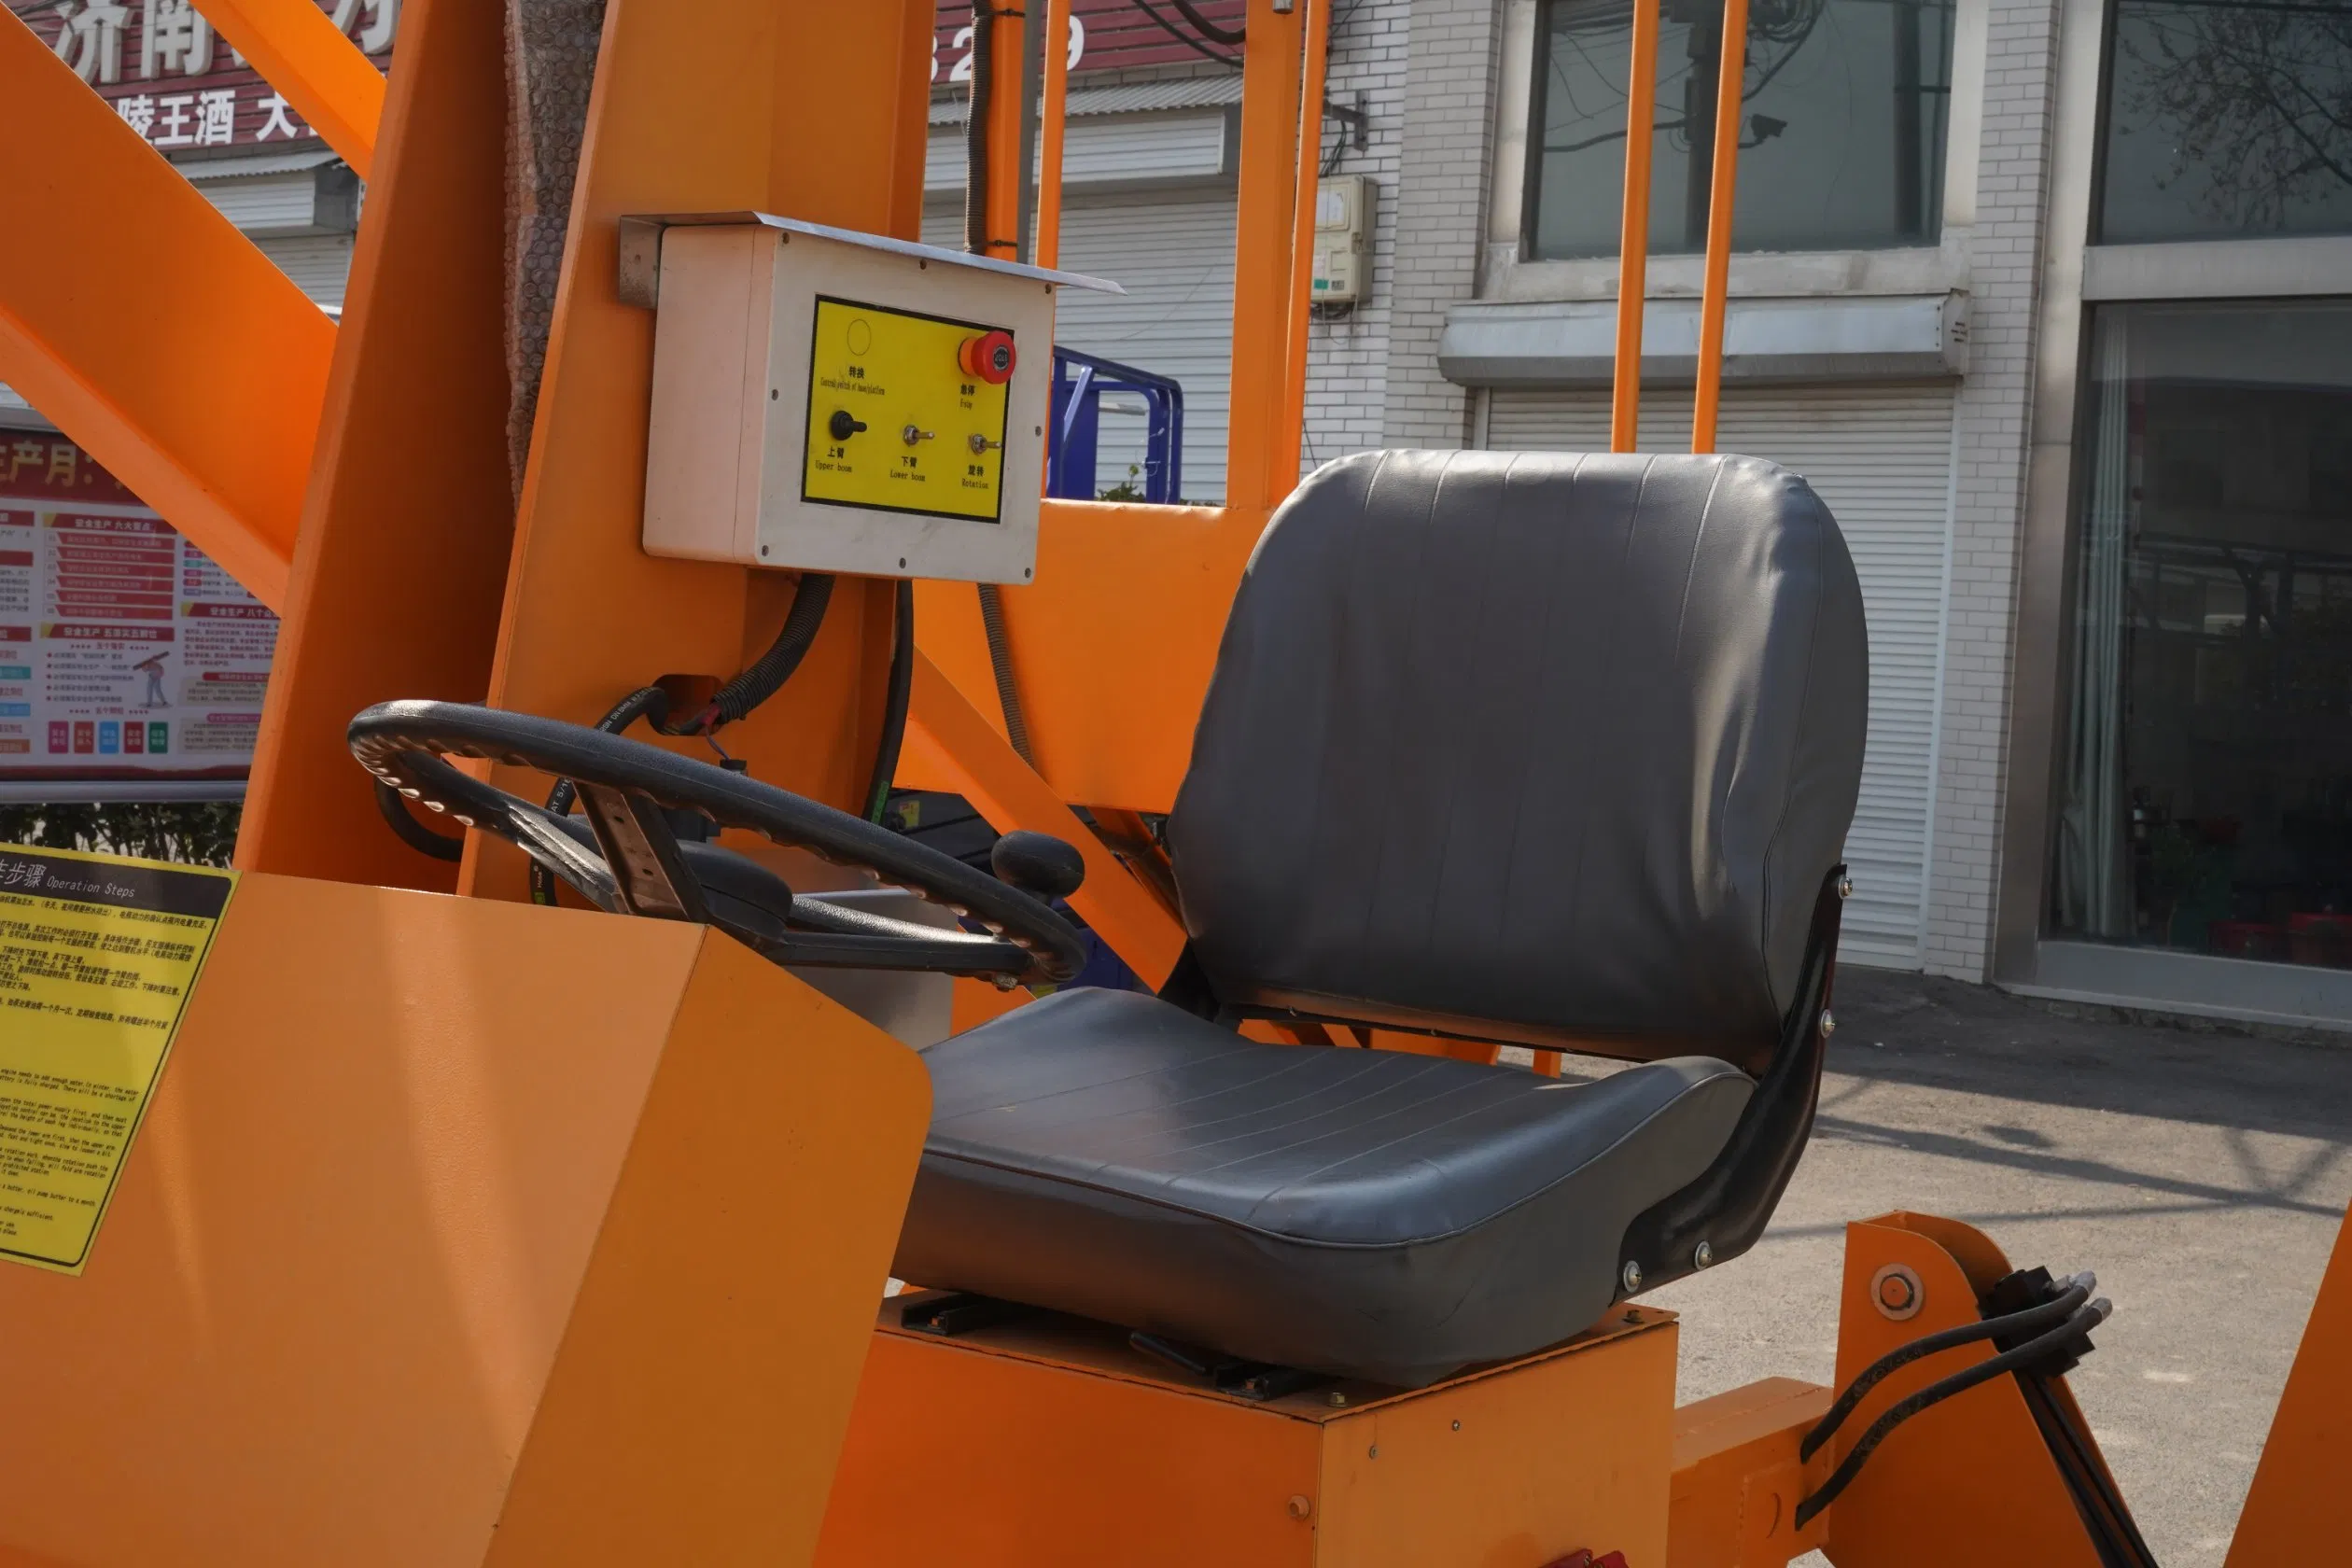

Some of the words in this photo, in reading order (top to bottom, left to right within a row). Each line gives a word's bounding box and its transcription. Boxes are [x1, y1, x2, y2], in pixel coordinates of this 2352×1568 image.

[827, 445, 845, 459] 上臂
[815, 459, 833, 470] Upper
[837, 462, 852, 473] boom
[902, 455, 917, 469] 下臂
[890, 468, 908, 480] Lower
[911, 471, 926, 482] boom
[968, 465, 985, 477] 旋转
[961, 477, 989, 490] Rotation
[47, 875, 101, 893] Operation
[105, 882, 135, 899] Steps
